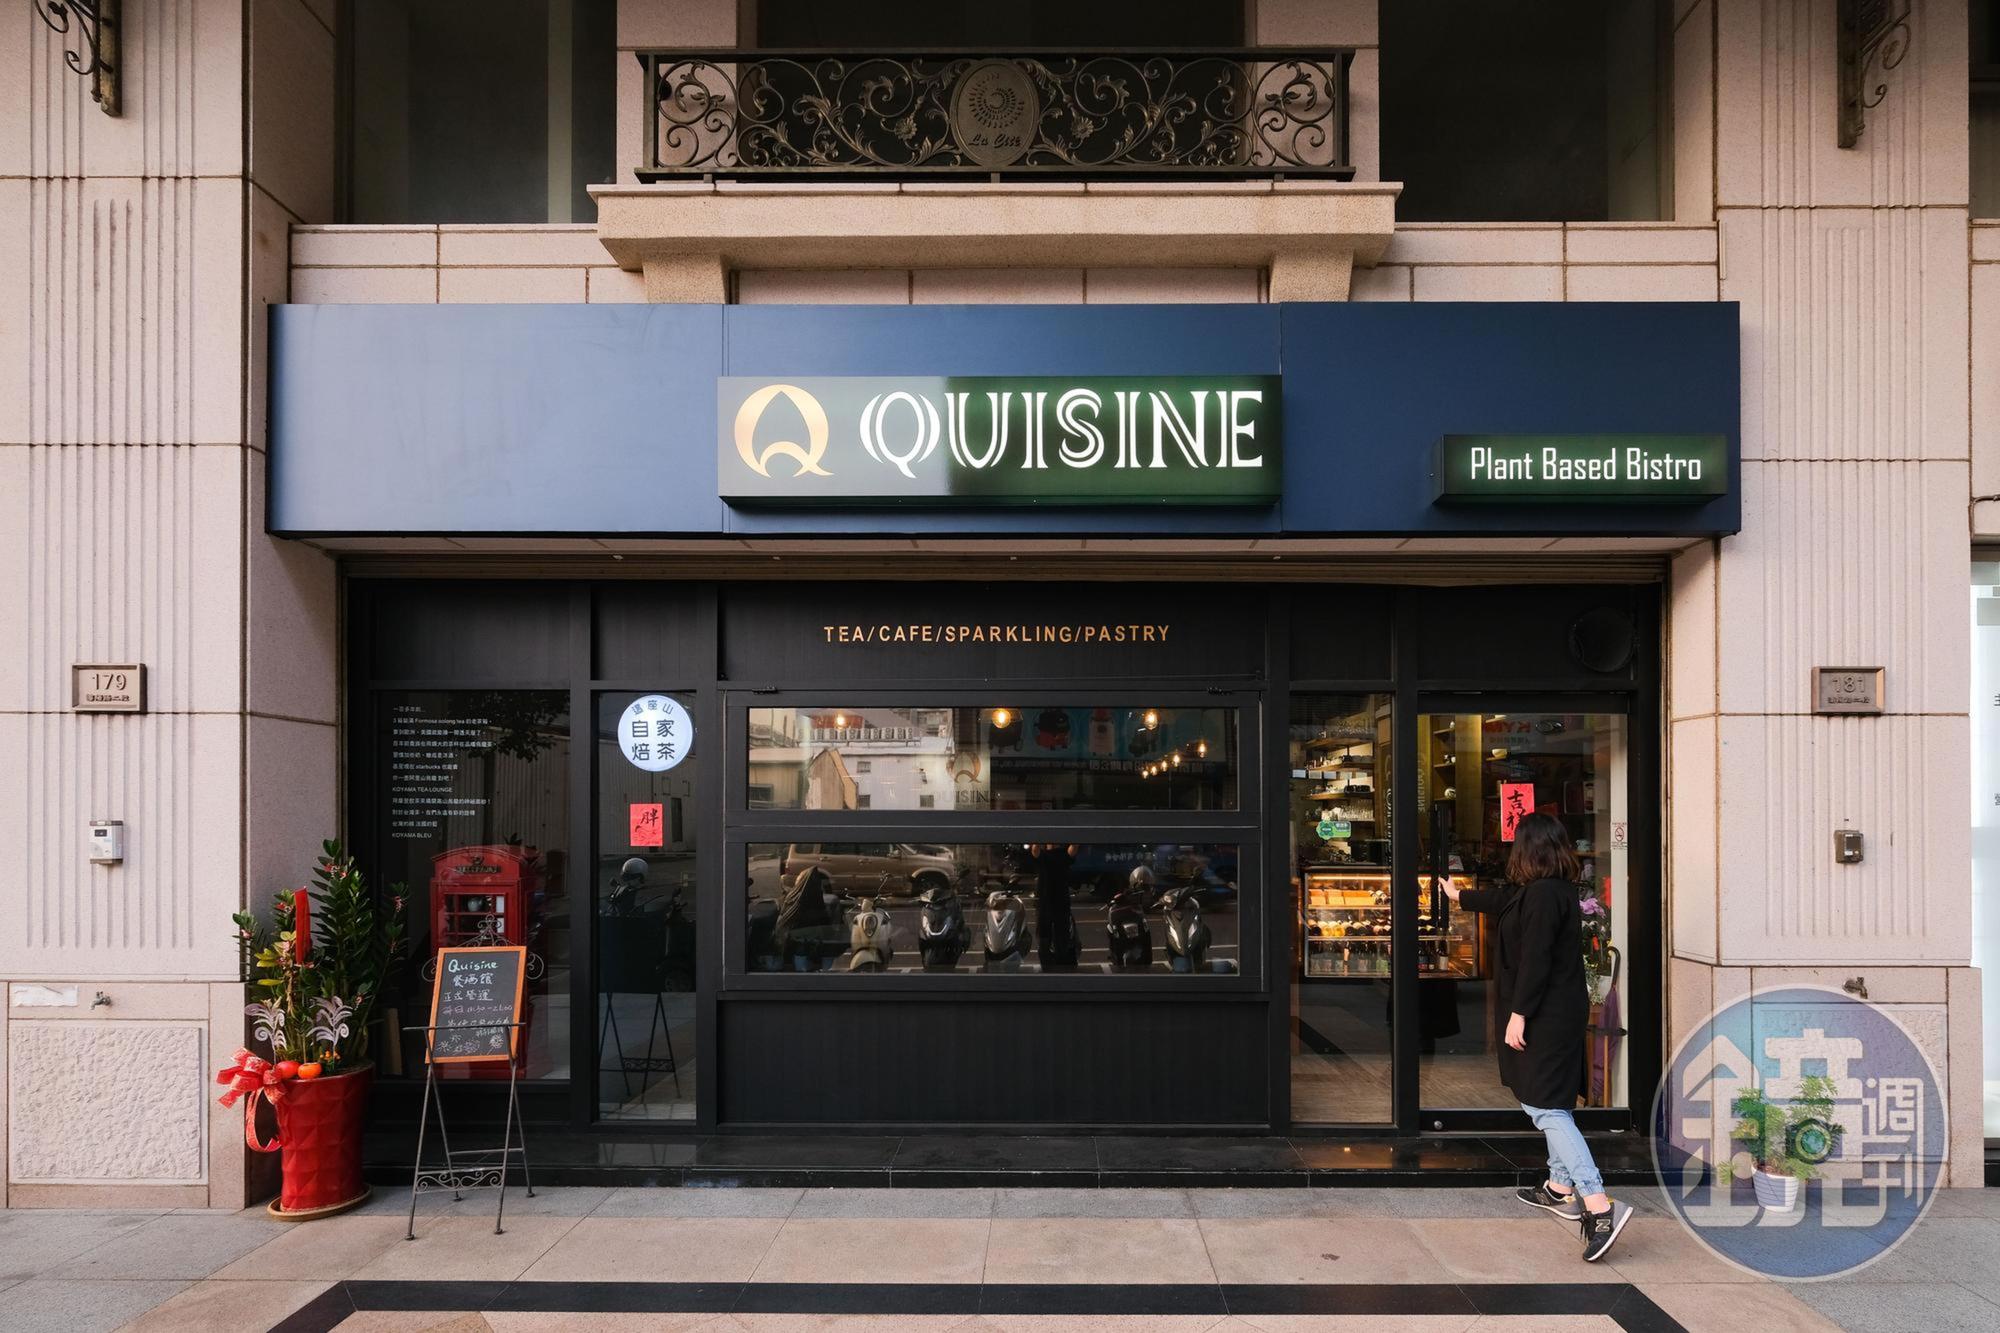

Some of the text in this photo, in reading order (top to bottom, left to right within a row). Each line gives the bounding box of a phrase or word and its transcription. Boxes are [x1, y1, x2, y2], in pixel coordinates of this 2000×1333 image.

[858, 387, 1264, 479] QUISINE
[1470, 447, 1702, 480] Plant Based Bistro
[823, 625, 1171, 643] TEA/CAFE/SPARKLING/PASTRY
[92, 673, 127, 691] 179
[1832, 675, 1865, 693] 181
[631, 719, 676, 738] 自家
[631, 743, 676, 761] 焙茶
[448, 959, 498, 974] Quisine
